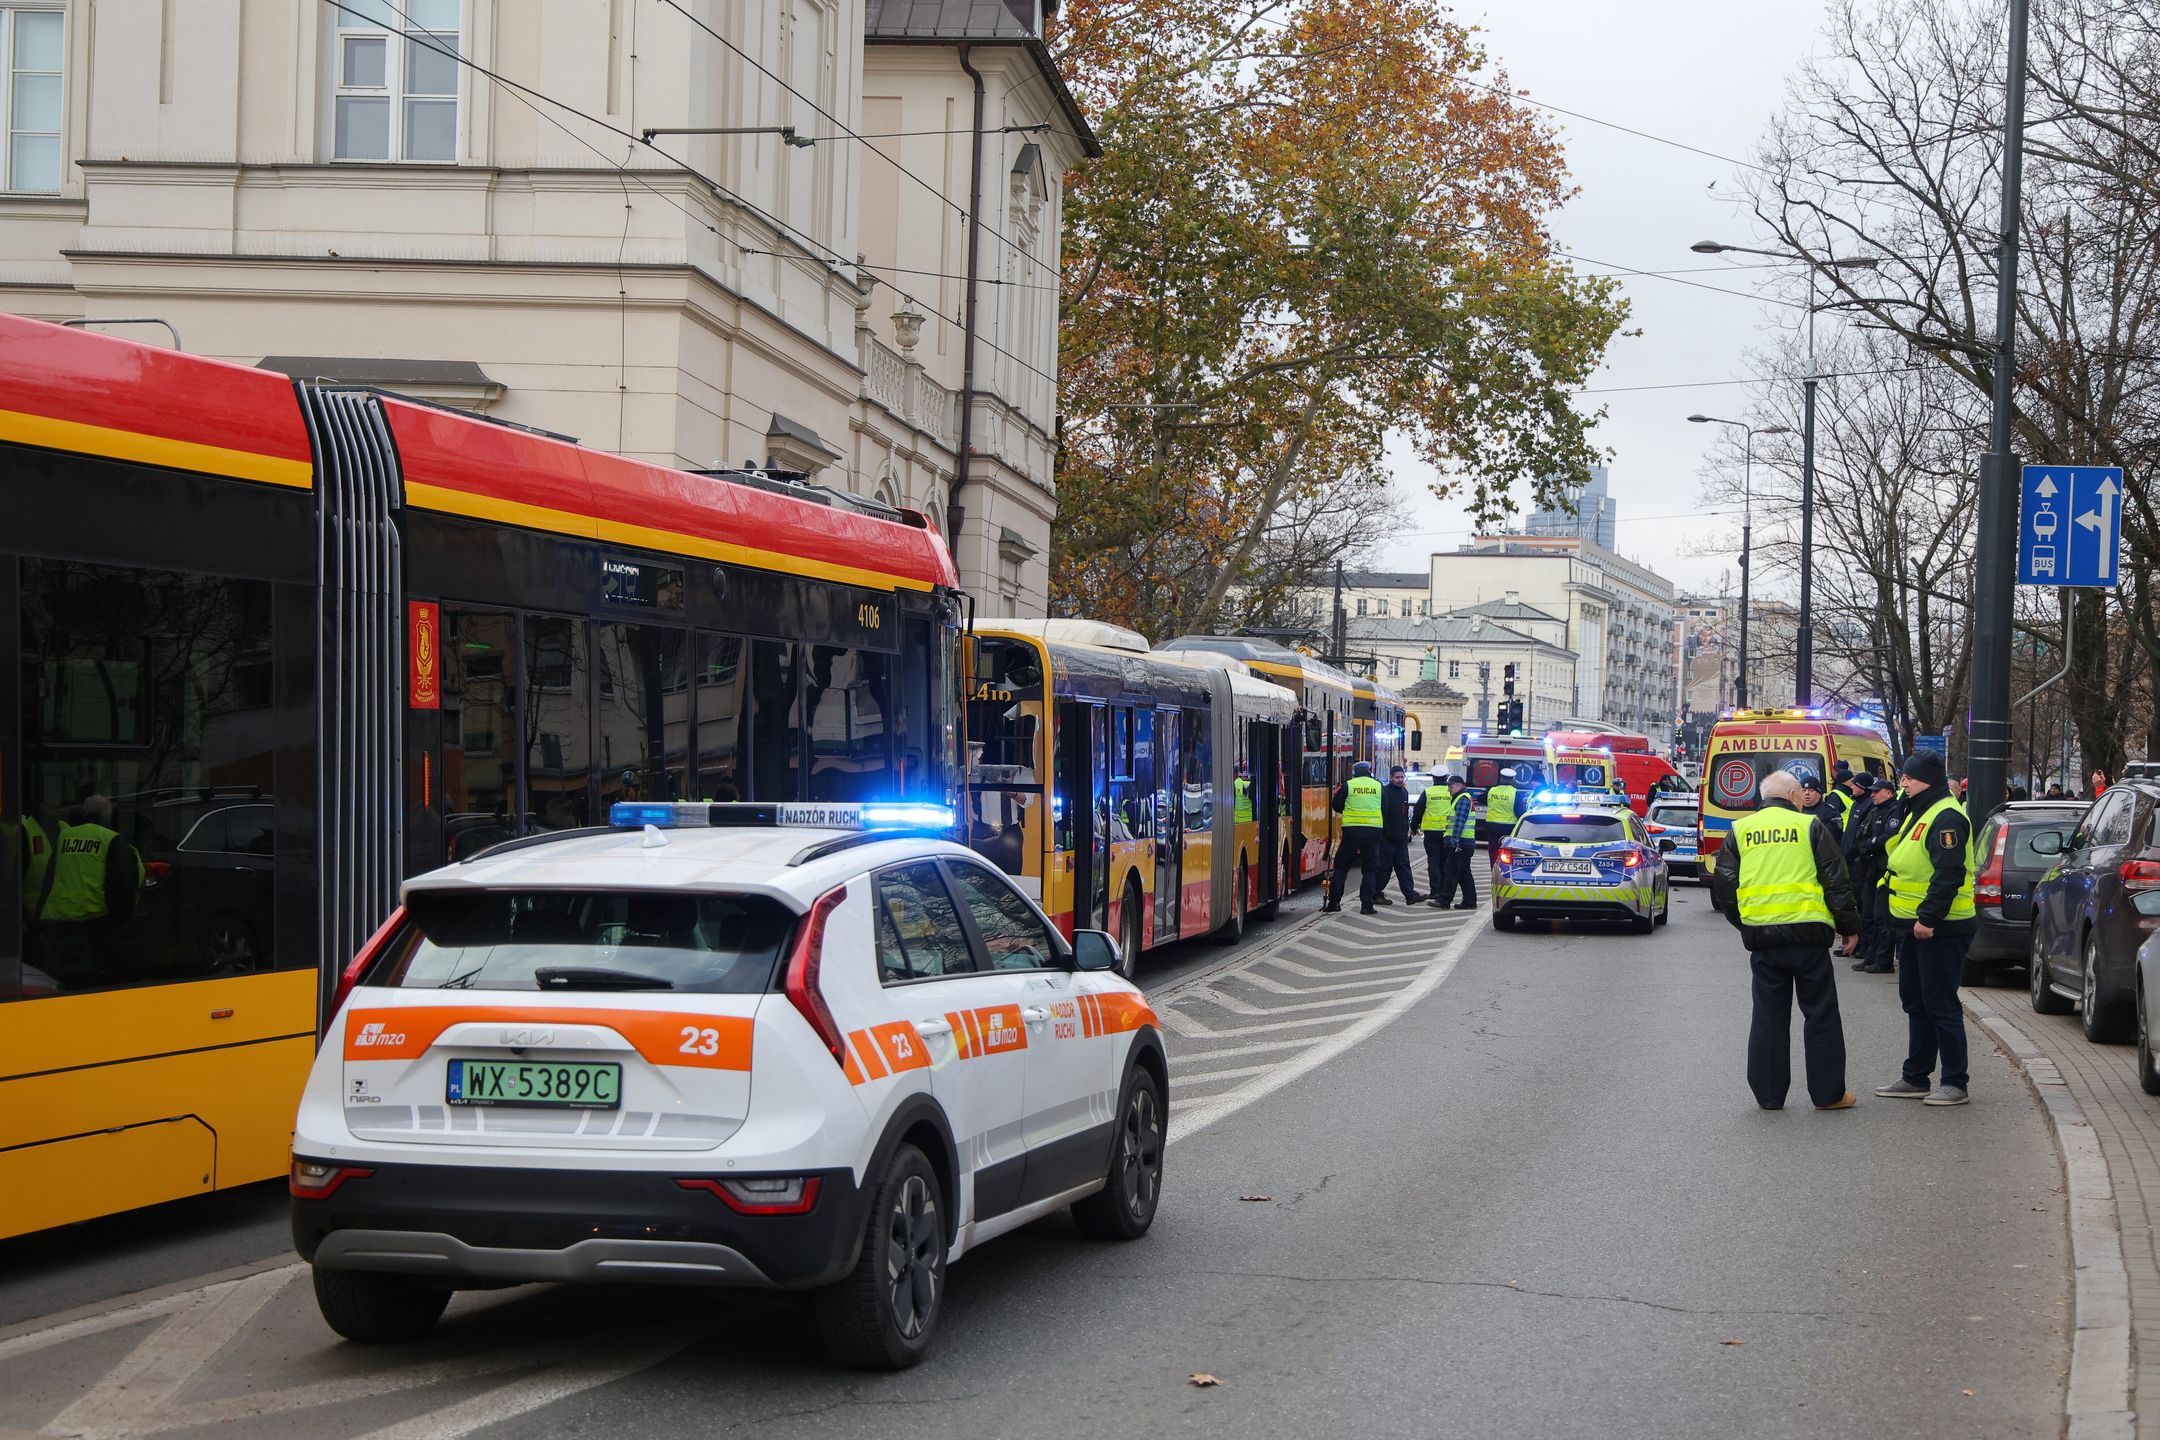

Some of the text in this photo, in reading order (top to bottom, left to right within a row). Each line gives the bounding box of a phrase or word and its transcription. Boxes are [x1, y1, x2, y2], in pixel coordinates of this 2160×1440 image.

[2034, 559, 2053, 568] BUS
[858, 603, 880, 629] 4106
[1720, 738, 1818, 752] AMBULANS
[1558, 756, 1602, 765] AMBULANS
[1728, 768, 1746, 790] P
[1353, 787, 1377, 795] POLICJA
[785, 805, 826, 824] NADZÓR
[1746, 828, 1799, 847] POLICJA
[1548, 862, 1589, 872] HPZ C544
[1050, 1000, 1076, 1019] NADZÓR
[500, 1029, 556, 1046] KIA
[1054, 1022, 1076, 1039] RUCHU
[678, 1025, 720, 1056] 23
[891, 1032, 914, 1058] 23
[450, 1084, 462, 1094] PL
[469, 1065, 611, 1100] WX 5389C
[349, 1095, 382, 1104] NIRO
